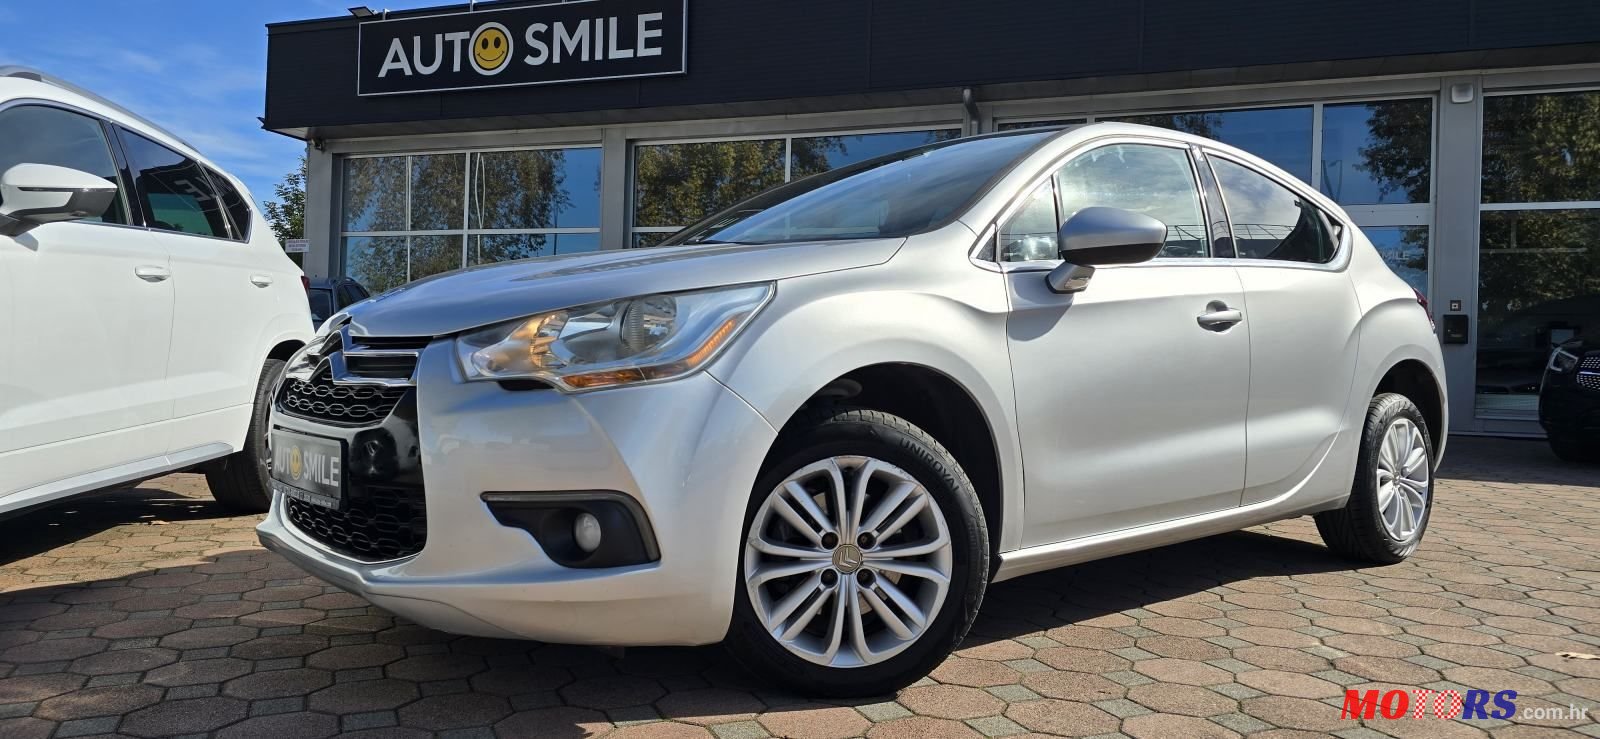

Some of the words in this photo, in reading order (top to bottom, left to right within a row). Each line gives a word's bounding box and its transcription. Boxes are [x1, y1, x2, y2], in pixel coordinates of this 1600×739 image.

[378, 21, 514, 78] AUTO
[523, 12, 663, 66] SMILE
[274, 444, 302, 481] AUTO
[303, 450, 339, 487] SMILE
[900, 437, 960, 492] UNIROYAL
